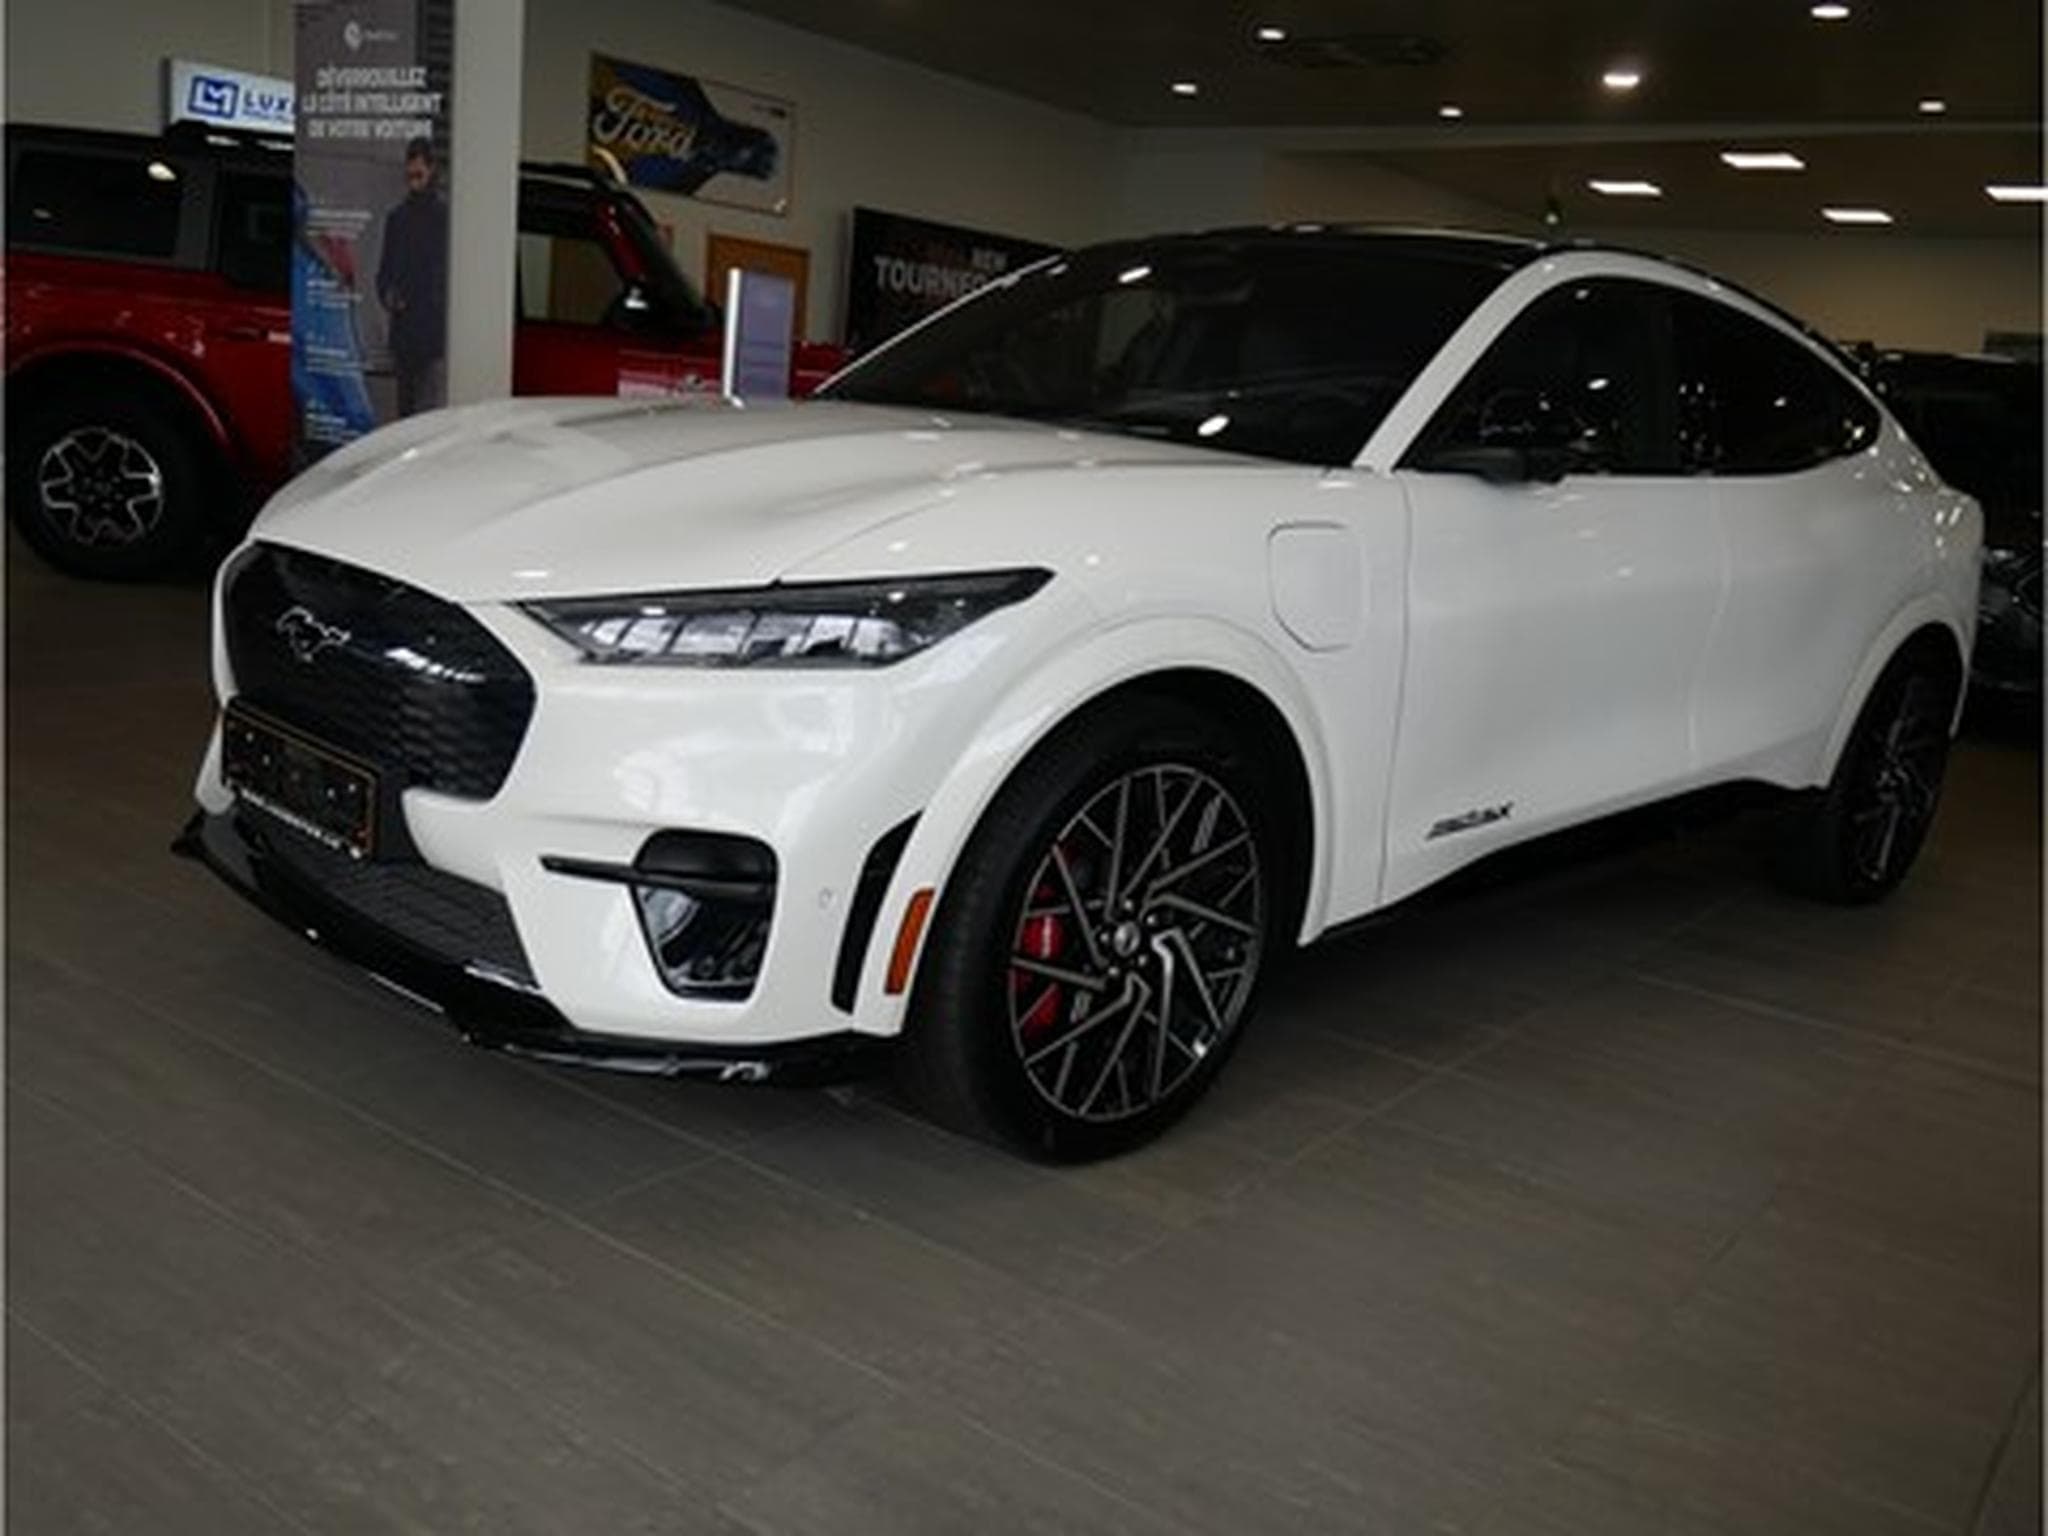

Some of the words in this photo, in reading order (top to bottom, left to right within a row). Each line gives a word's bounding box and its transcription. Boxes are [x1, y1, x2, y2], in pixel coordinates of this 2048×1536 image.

[243, 89, 294, 114] LUX
[354, 92, 442, 115] INTELLIGENT
[592, 84, 699, 163] Ford
